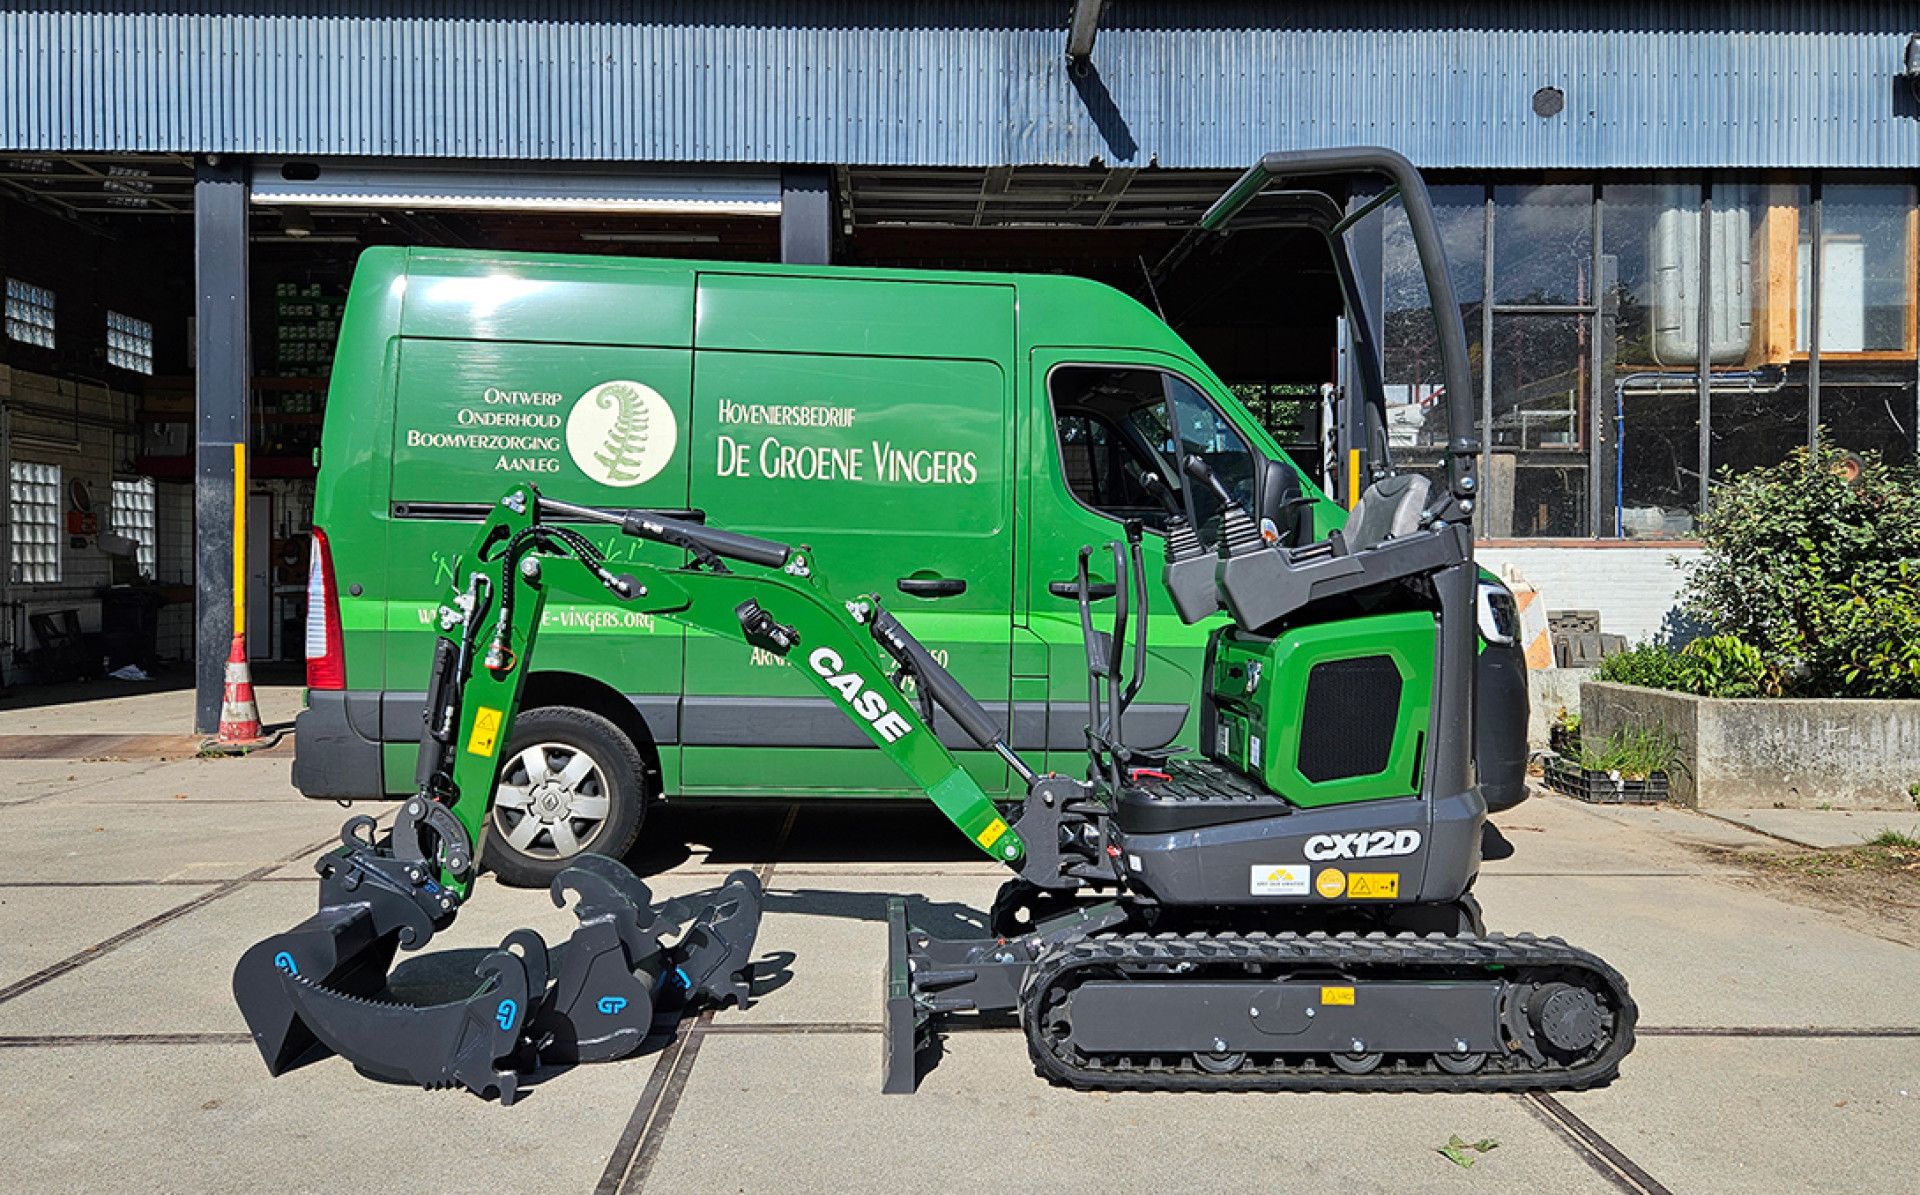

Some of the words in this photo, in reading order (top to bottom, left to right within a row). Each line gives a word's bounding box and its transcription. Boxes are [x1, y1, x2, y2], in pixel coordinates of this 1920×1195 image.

[484, 387, 562, 406] ONTWERP
[457, 408, 562, 428] ONDERHOUD
[718, 399, 856, 427] HOVENIERSBEDRIJF
[407, 429, 560, 451] BOOMVERZORGING
[495, 454, 560, 473] AANLEG
[717, 436, 751, 477] DE
[759, 436, 863, 480] GROENE
[872, 441, 977, 484] VINGERS
[808, 646, 913, 744] CASE
[1303, 829, 1422, 861] CX12D
[597, 996, 627, 1015] GP
